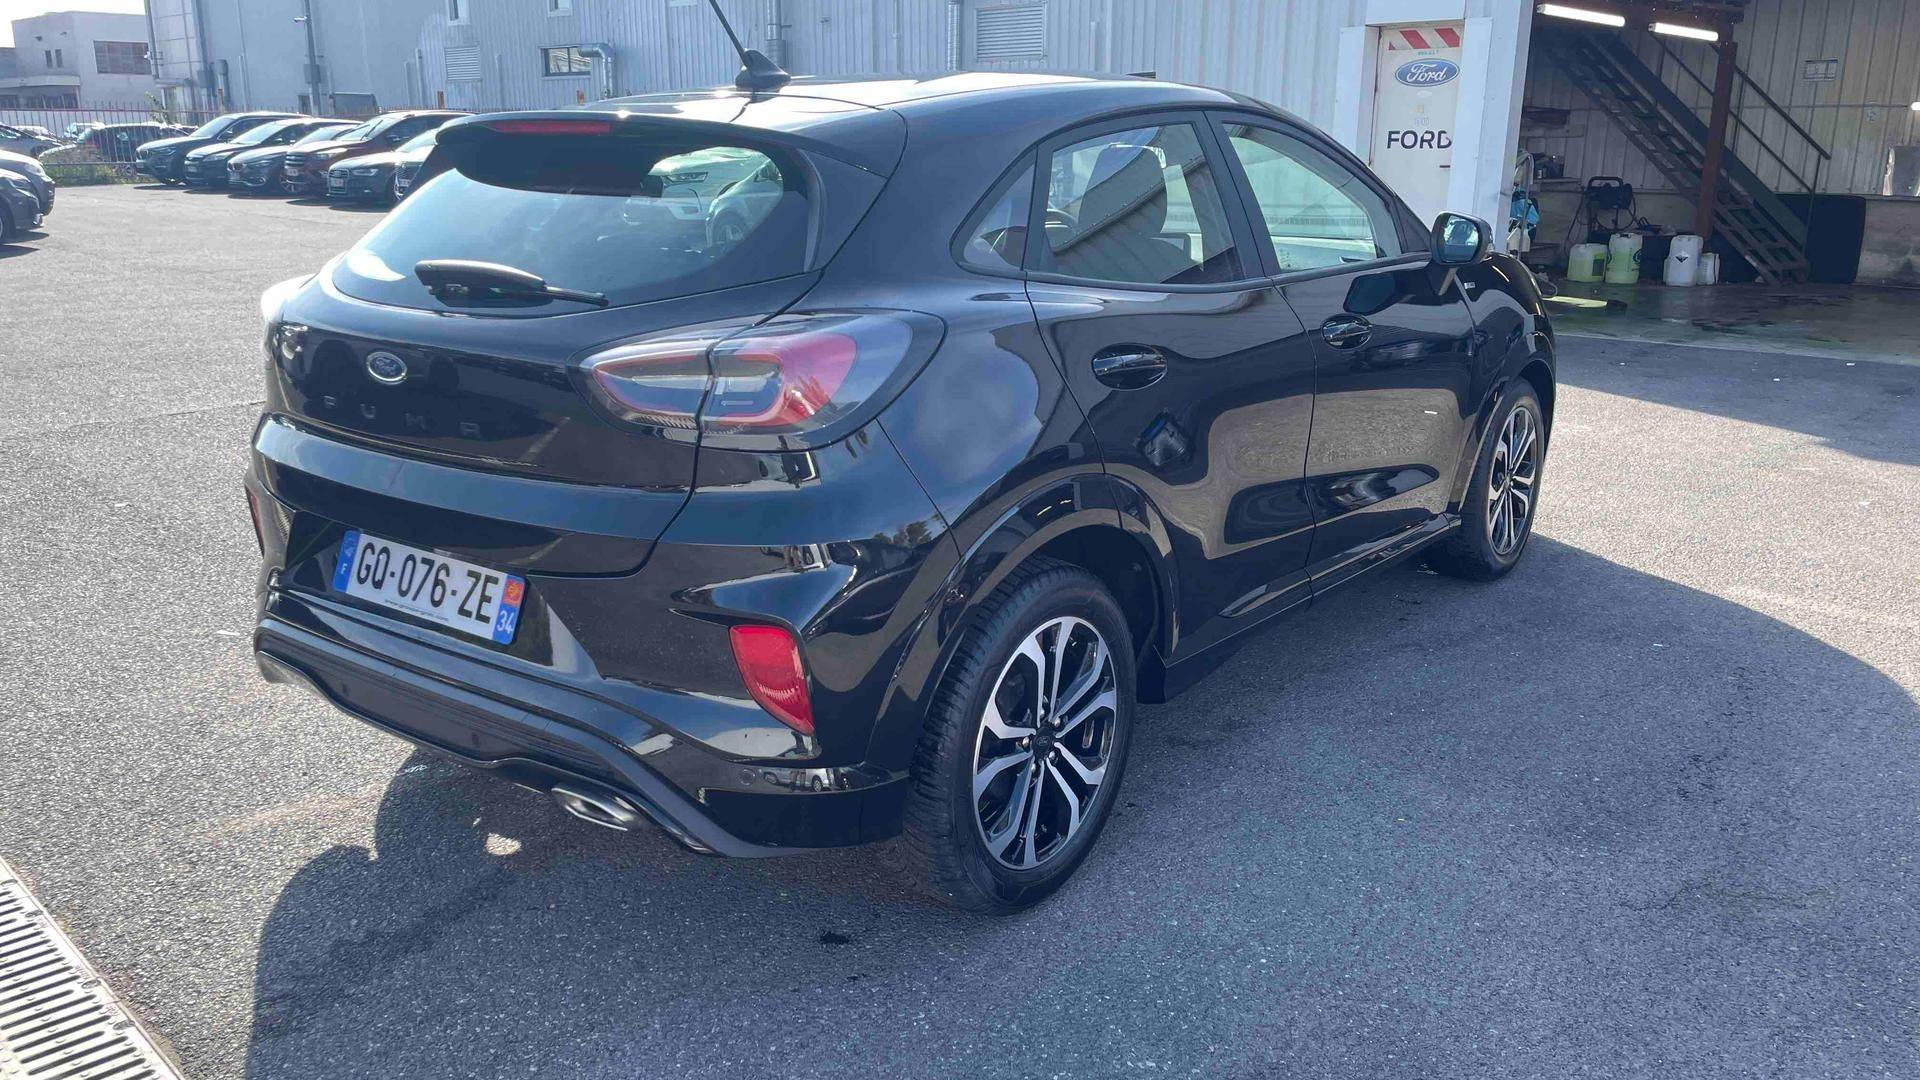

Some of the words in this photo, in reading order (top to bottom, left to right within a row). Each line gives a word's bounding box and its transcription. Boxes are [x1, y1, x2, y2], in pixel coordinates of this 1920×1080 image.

[1406, 63, 1447, 83] Ford
[1387, 130, 1453, 149] FORD
[340, 563, 348, 575] F
[356, 542, 499, 625] GQ-076-ZE
[496, 609, 515, 635] 34
